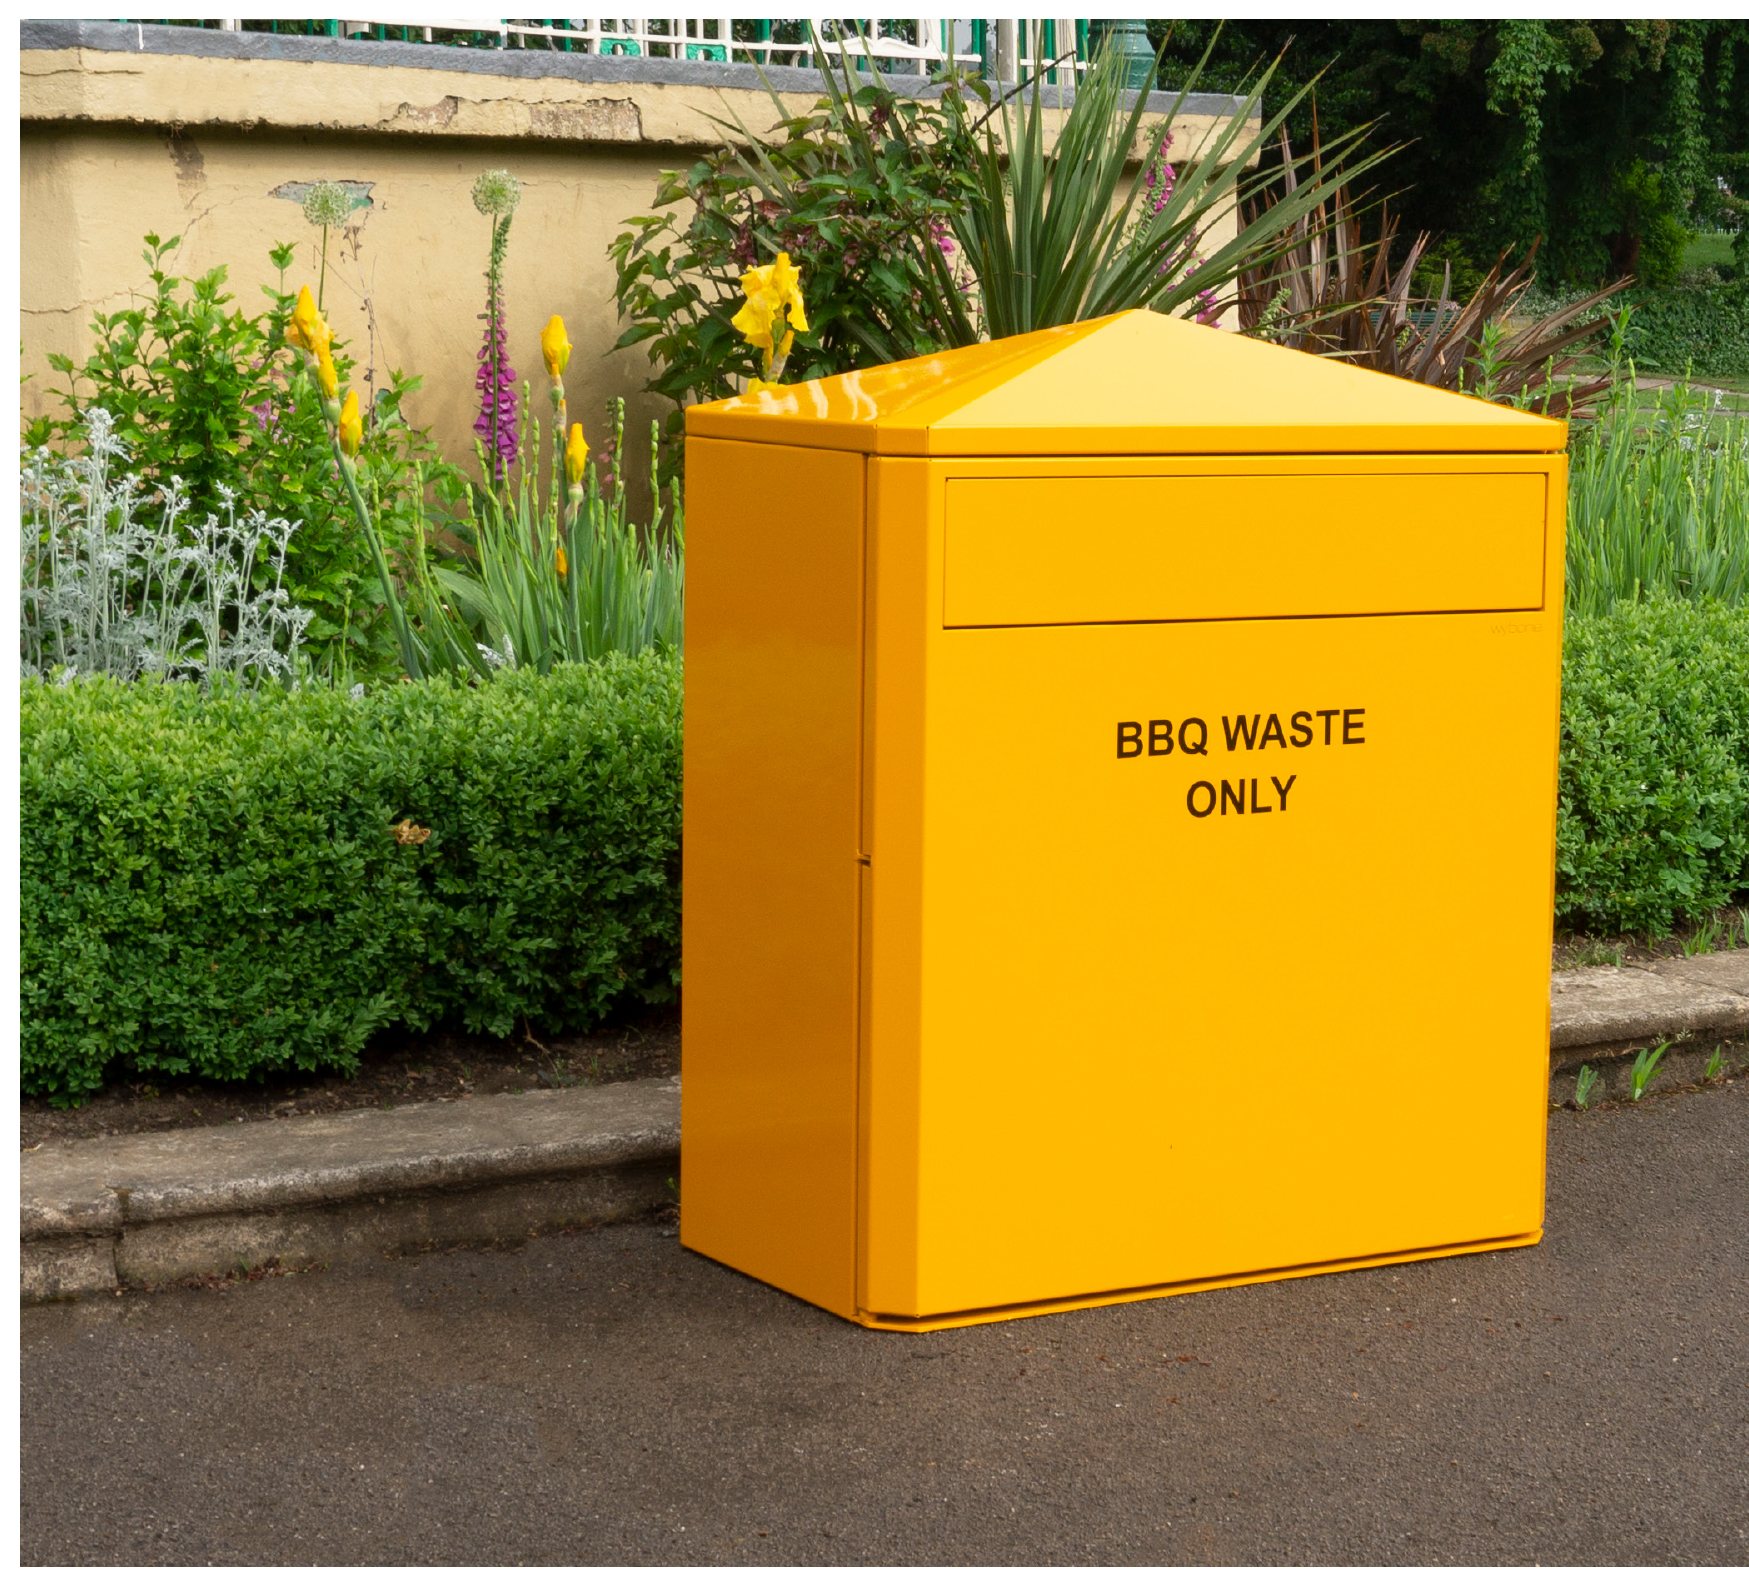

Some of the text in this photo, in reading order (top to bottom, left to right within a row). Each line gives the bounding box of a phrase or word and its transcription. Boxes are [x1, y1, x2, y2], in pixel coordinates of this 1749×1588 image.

[1117, 708, 1366, 758] BBQ WASTE
[1186, 774, 1297, 818] ONLY
